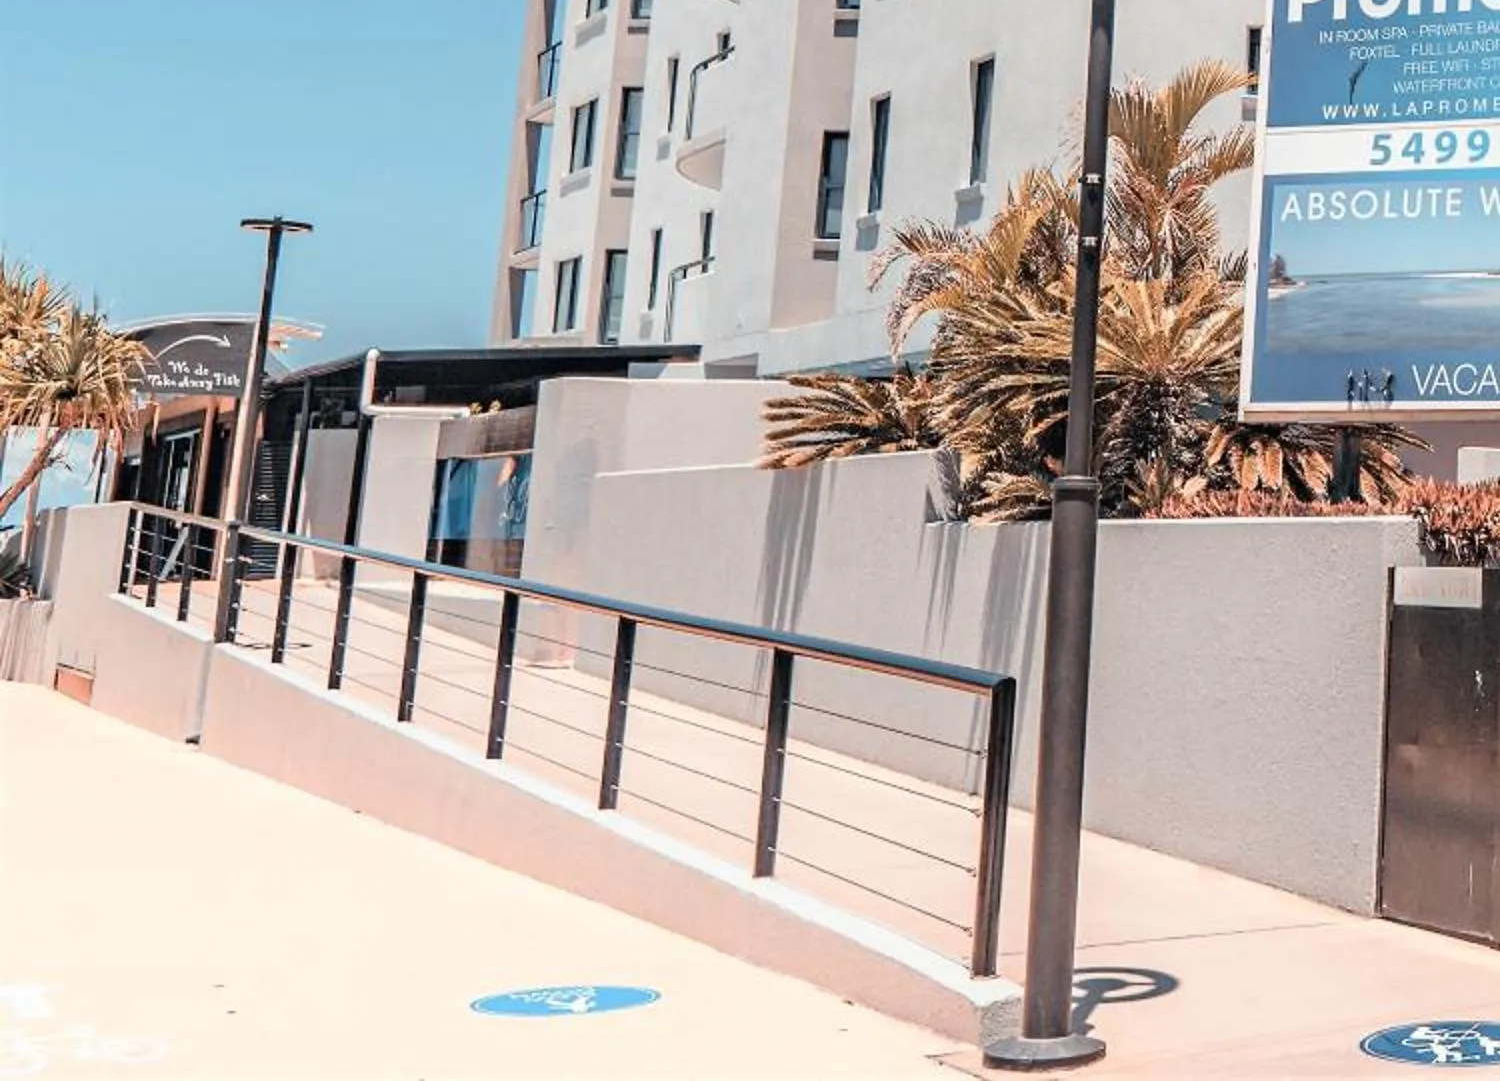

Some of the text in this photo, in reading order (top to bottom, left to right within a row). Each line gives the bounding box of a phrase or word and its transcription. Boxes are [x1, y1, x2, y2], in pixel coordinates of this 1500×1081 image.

[1319, 31, 1333, 44] IN
[1336, 28, 1379, 43] ROOM
[1382, 26, 1408, 40] SPA
[1419, 22, 1473, 37] PRIVATE
[1350, 44, 1400, 60] FOXTEL
[1411, 41, 1443, 56] FULL
[1402, 61, 1439, 75] FREE
[1393, 77, 1486, 95] WATERFRONT
[1369, 129, 1491, 166] 5499
[1280, 187, 1462, 222] ABSOLUTE
